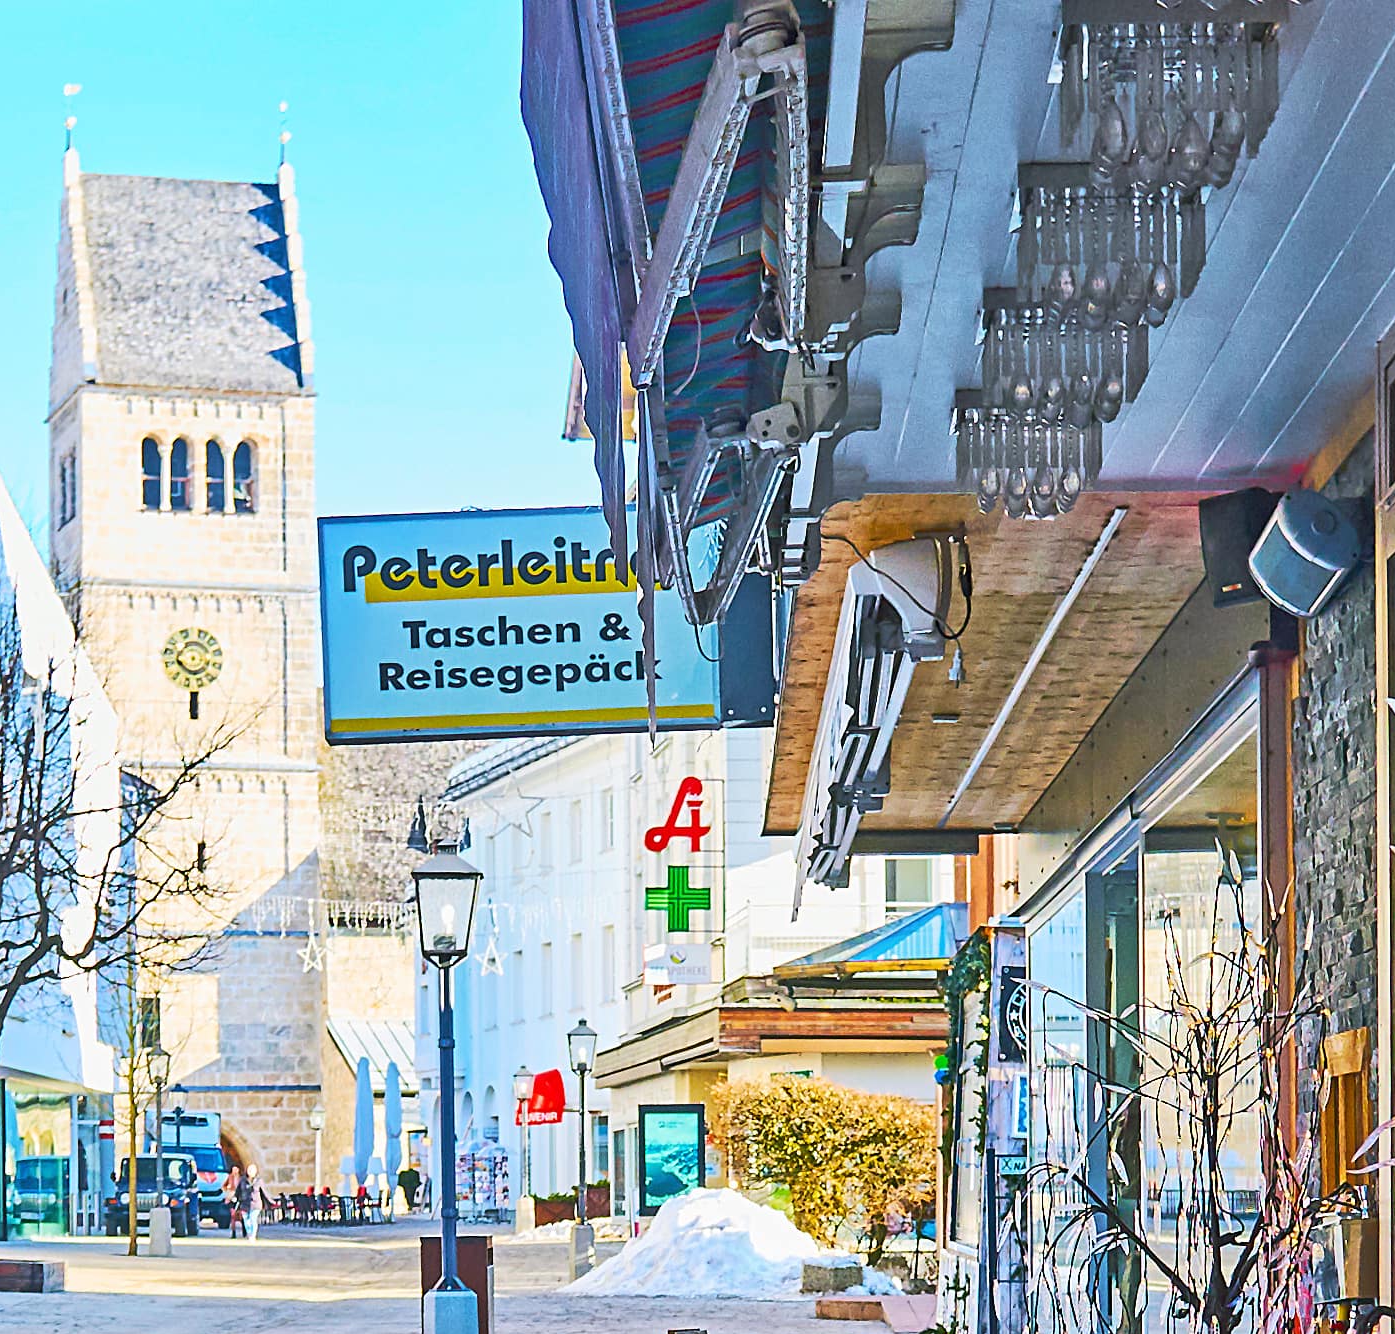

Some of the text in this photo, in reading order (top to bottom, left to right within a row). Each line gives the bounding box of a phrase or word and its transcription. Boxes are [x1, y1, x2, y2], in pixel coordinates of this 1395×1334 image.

[343, 536, 639, 593] Peterleitn
[402, 612, 632, 649] Taschen &
[378, 651, 663, 694] Reisegepäck
